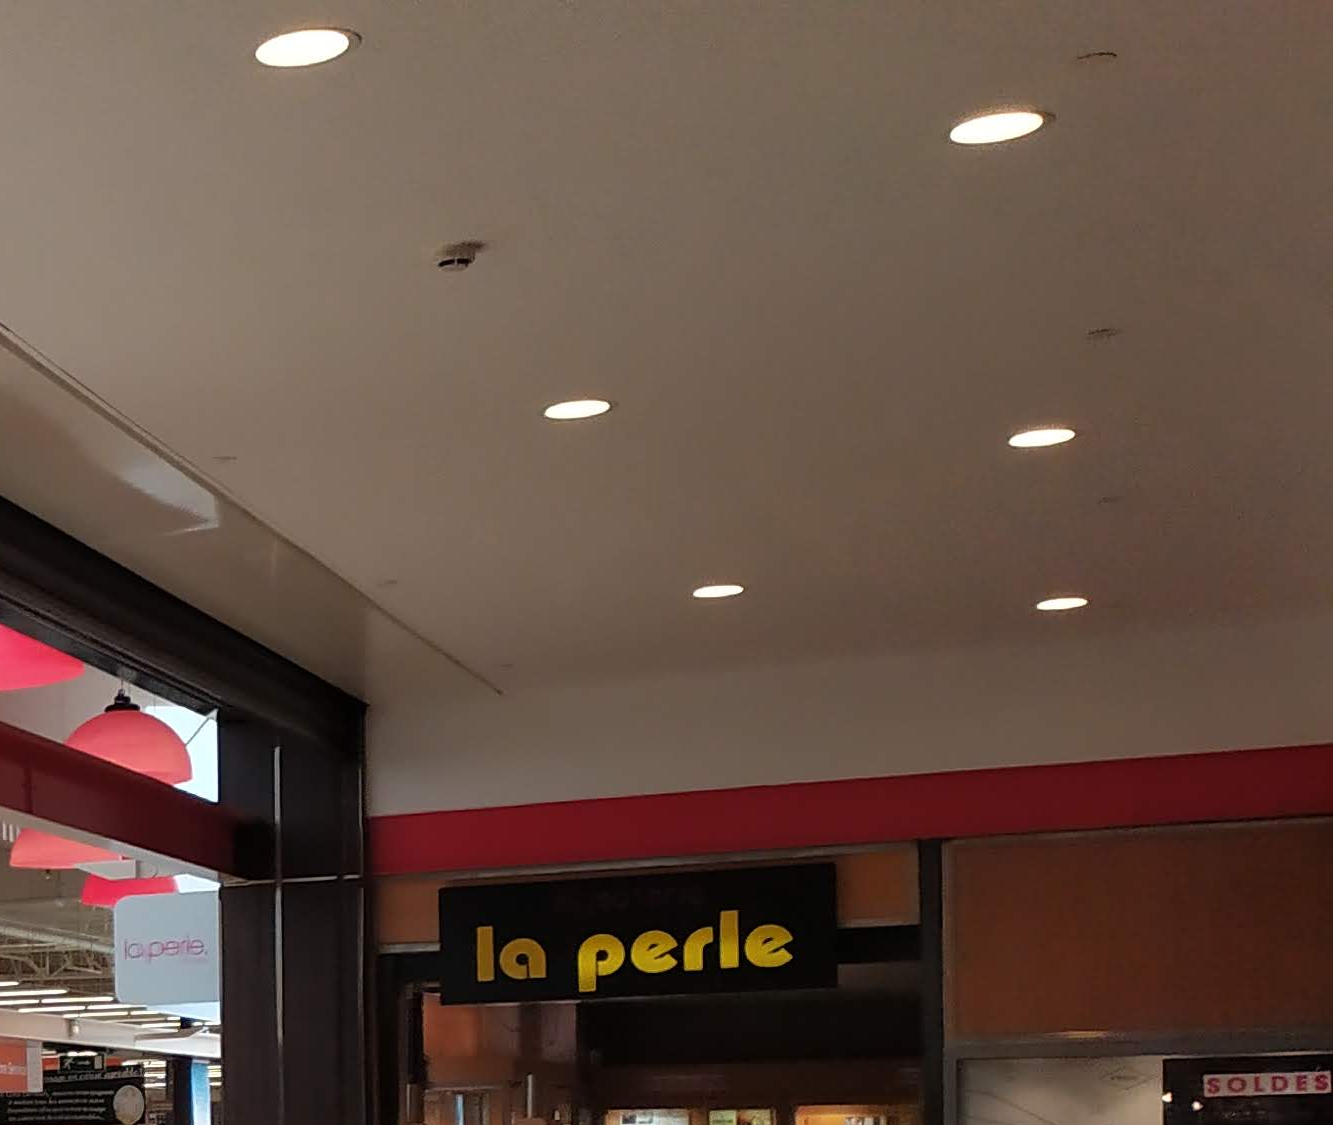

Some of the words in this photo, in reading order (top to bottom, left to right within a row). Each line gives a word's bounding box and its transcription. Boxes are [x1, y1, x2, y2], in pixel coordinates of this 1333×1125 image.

[476, 925, 547, 983] la
[577, 910, 794, 993] perle
[1206, 1073, 1329, 1095] SOLDES
